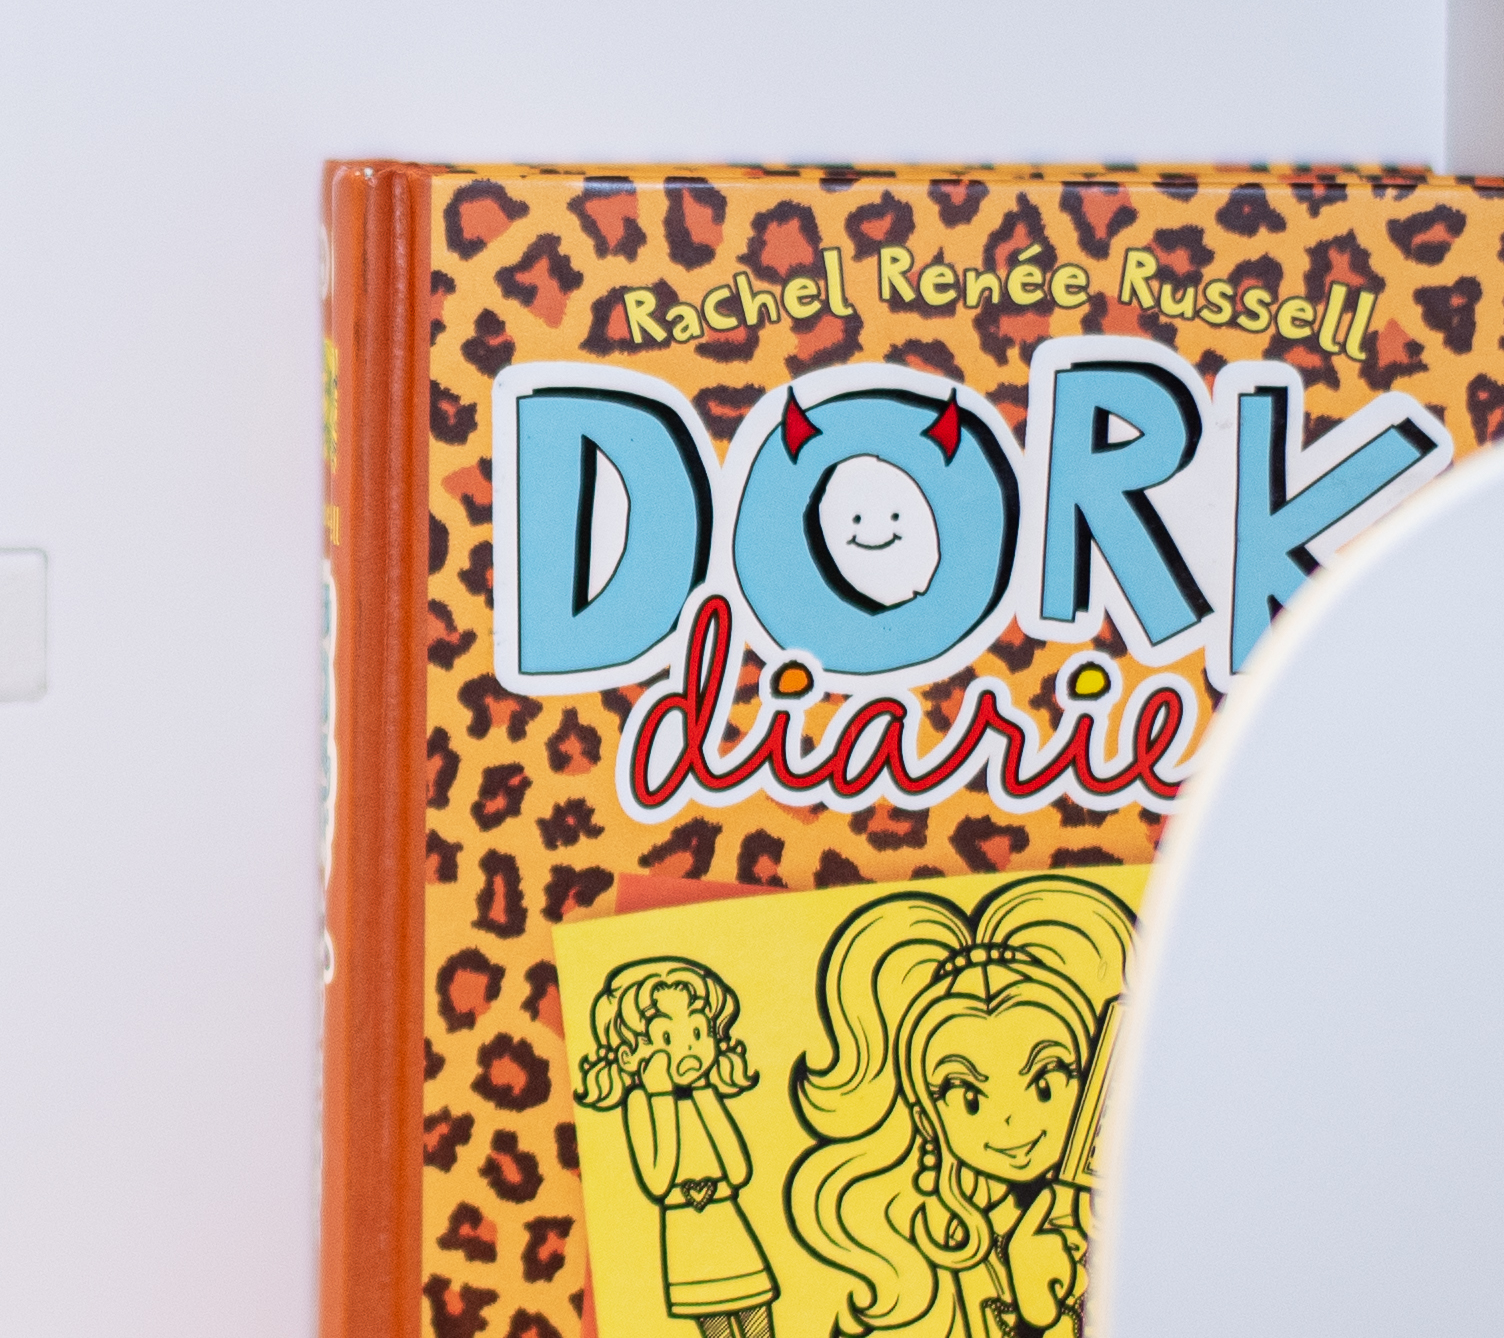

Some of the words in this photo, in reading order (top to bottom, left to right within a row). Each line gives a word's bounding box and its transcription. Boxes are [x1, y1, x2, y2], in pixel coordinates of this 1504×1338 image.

[622, 247, 854, 346] Rachel
[878, 244, 1090, 311] Renée
[1119, 246, 1377, 362] Russell
[516, 364, 1438, 675] DORK
[632, 595, 1184, 809] diarie
